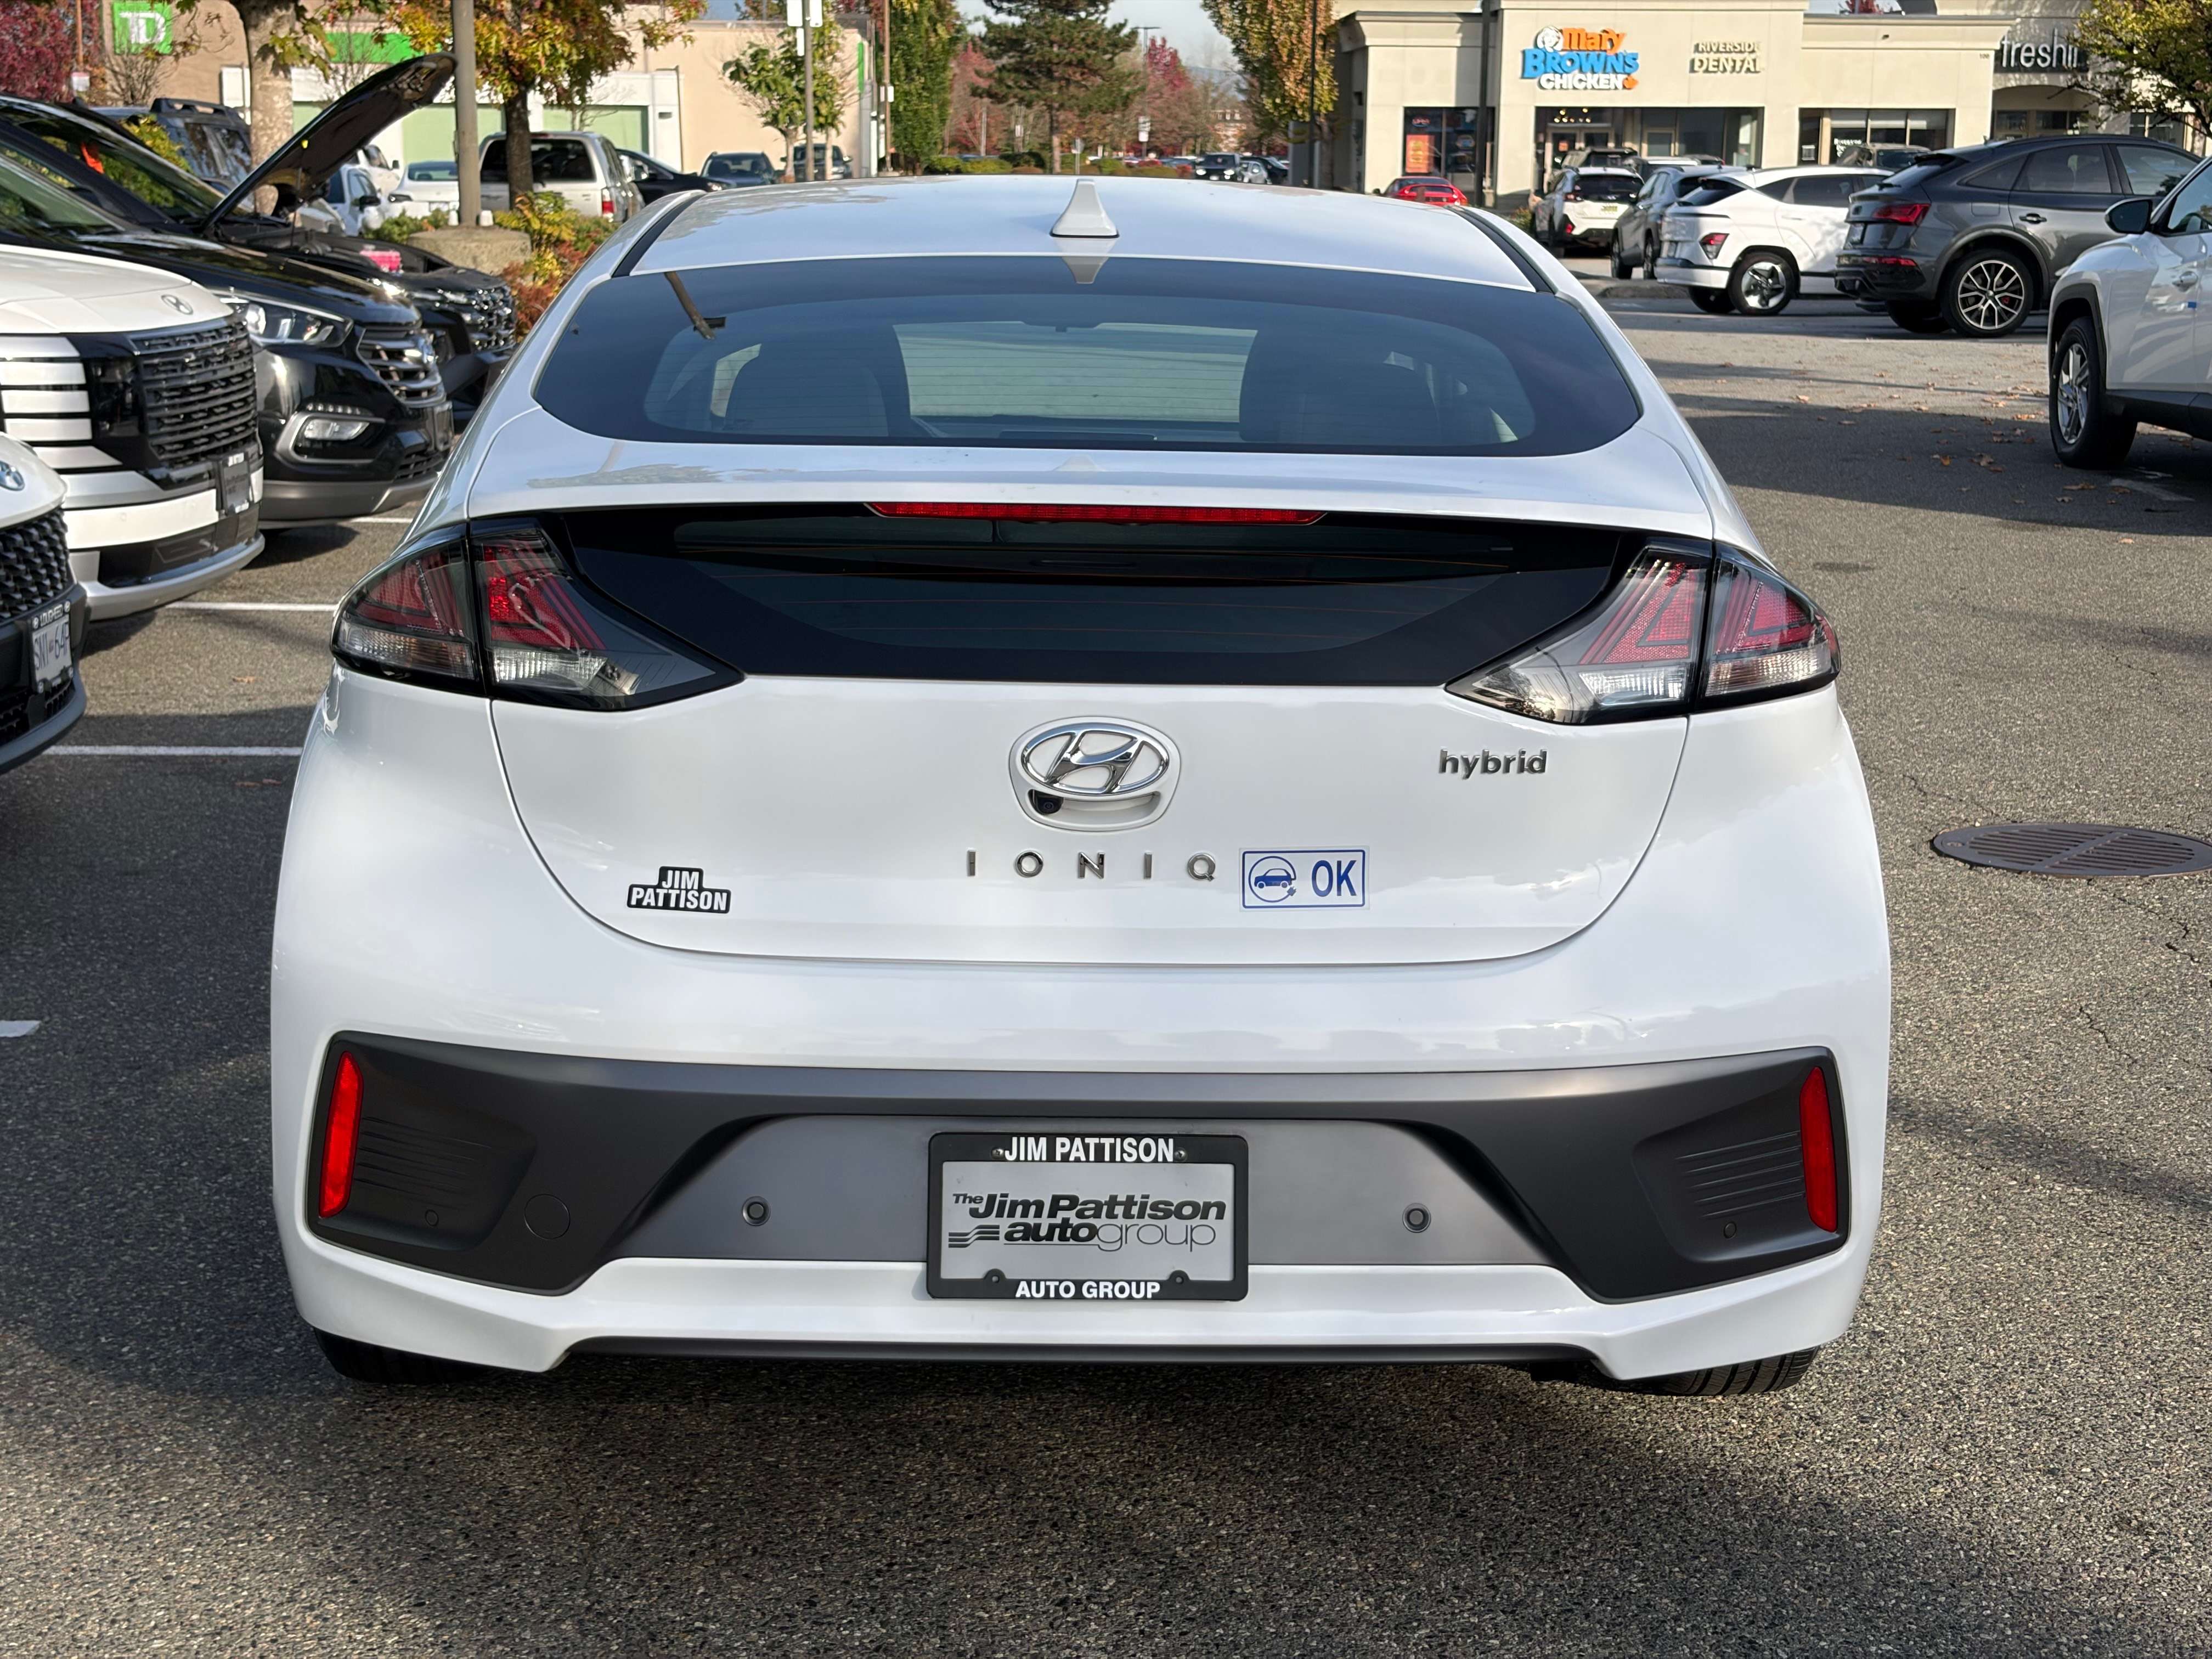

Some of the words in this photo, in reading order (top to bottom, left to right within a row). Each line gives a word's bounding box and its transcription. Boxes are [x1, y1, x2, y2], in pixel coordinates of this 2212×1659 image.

[119, 12, 166, 44] TD
[1523, 48, 1639, 78] BROWN'S
[1690, 57, 1763, 74] DENTAL
[1539, 73, 1624, 90] CHICKEN
[1439, 749, 1547, 780] hybrid
[967, 850, 1216, 882] IONIQ
[662, 870, 699, 889] JIM
[1311, 860, 1357, 897] OK
[631, 887, 727, 911] PATTISON
[1005, 1137, 1047, 1161] JIM
[1056, 1138, 1173, 1162] PATTISON
[953, 1193, 984, 1204] The
[1015, 1281, 1075, 1299] AUTO
[1082, 1281, 1160, 1299] GROUP
